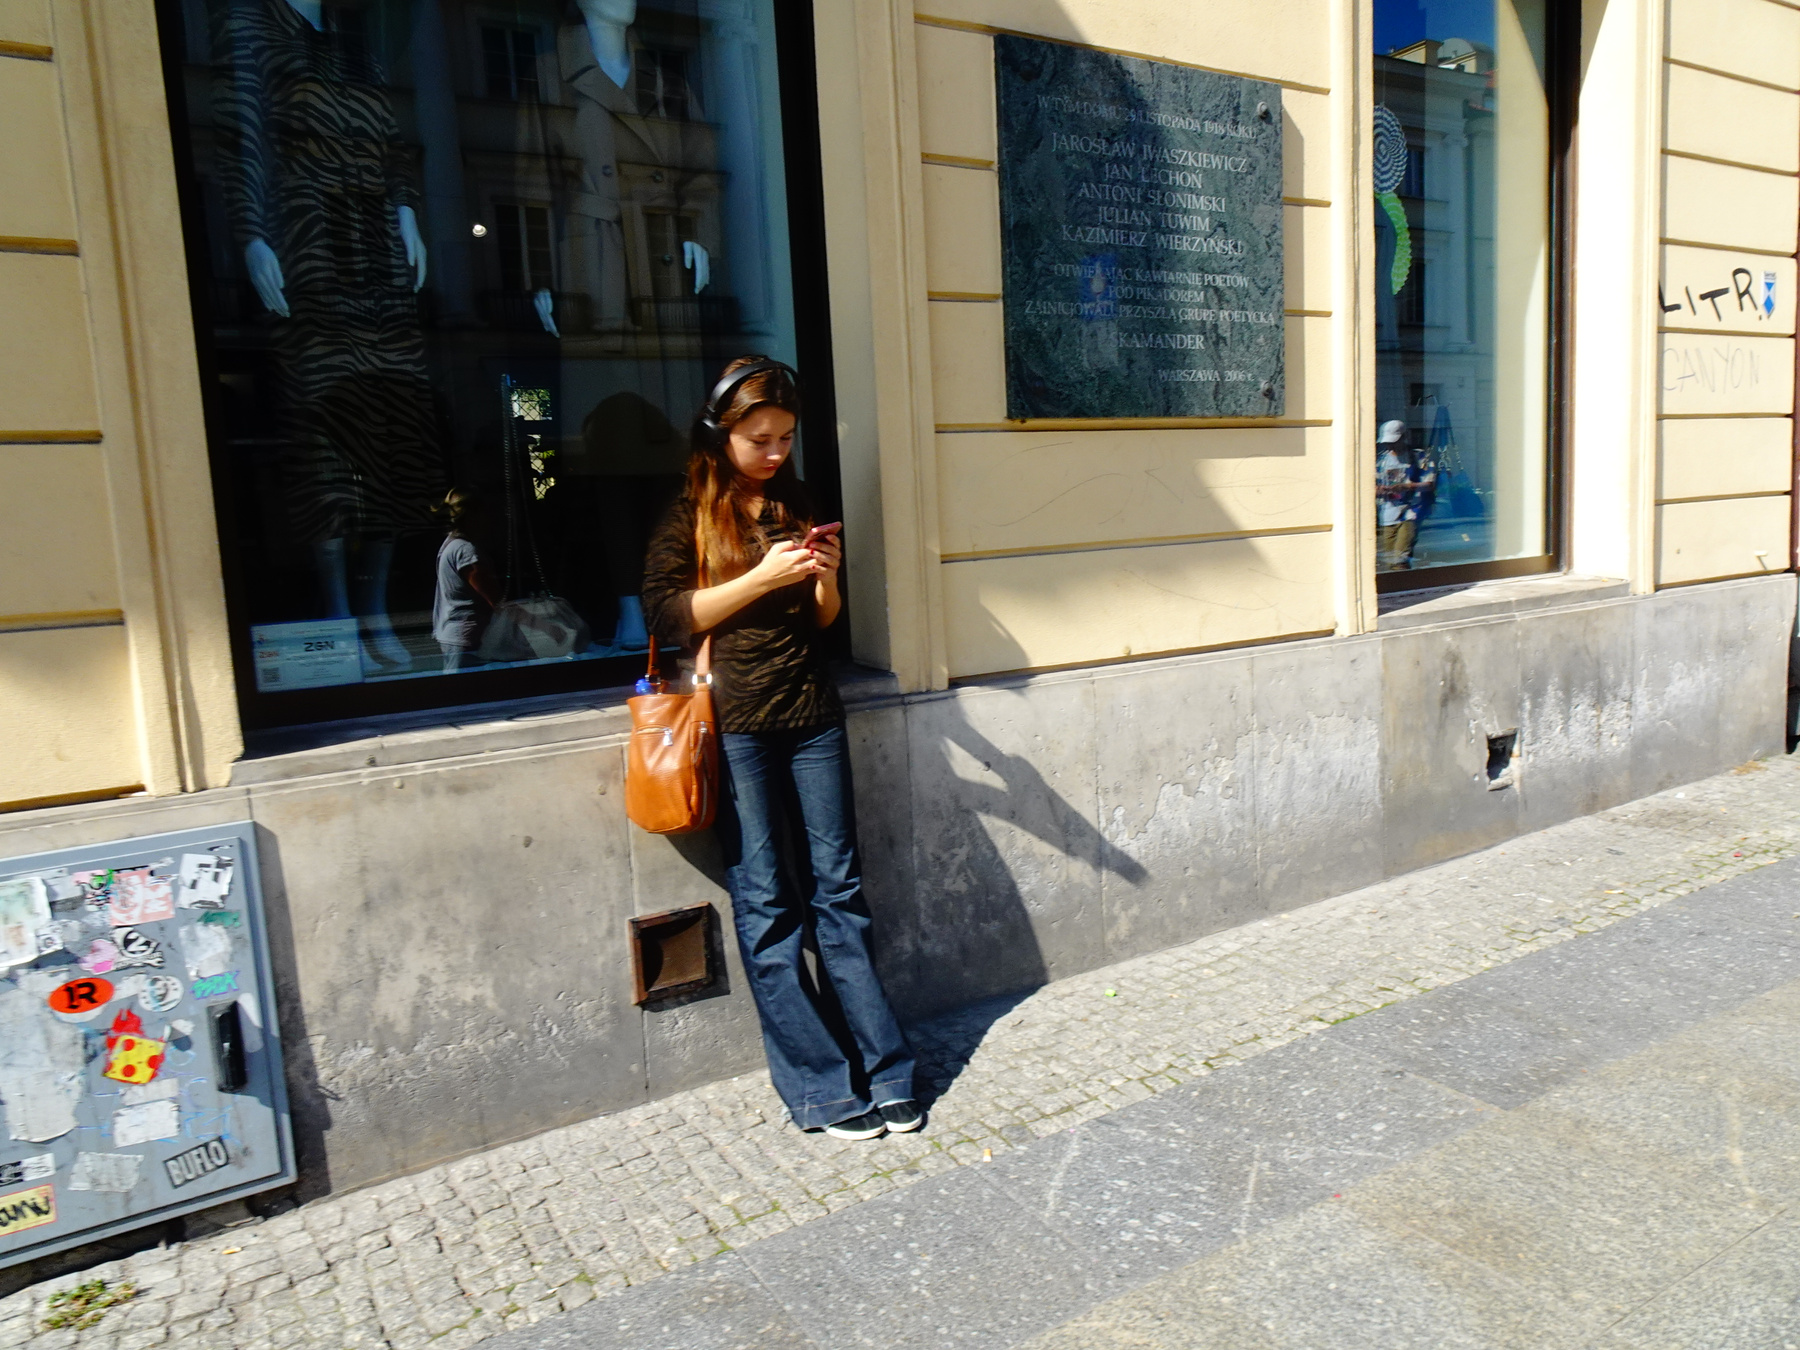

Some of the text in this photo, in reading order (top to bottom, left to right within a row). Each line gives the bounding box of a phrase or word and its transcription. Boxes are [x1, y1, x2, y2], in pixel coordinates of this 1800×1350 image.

[1202, 120, 1226, 135] 1918
[1227, 122, 1257, 139] ROKU
[1051, 132, 1248, 173] JAROSŁAW IWASZKIEWICZ
[1104, 162, 1134, 181] JAN
[1079, 182, 1227, 213] ANTONI SŁONIMSKI
[1098, 205, 1211, 232] JULIAN TUWIM
[1061, 224, 1245, 256] KAZIMIERZ WIERZYŃSKI
[1053, 263, 1133, 285] OTWIEAJĄC
[1203, 272, 1250, 288] POETÓW
[1108, 285, 1206, 302] POD PIKADOREM
[1110, 330, 1206, 350] SKAMANDER
[1157, 368, 1221, 382] WARSZAWA
[1662, 343, 1761, 394] CANYON
[165, 1140, 229, 1188] BUFLO
